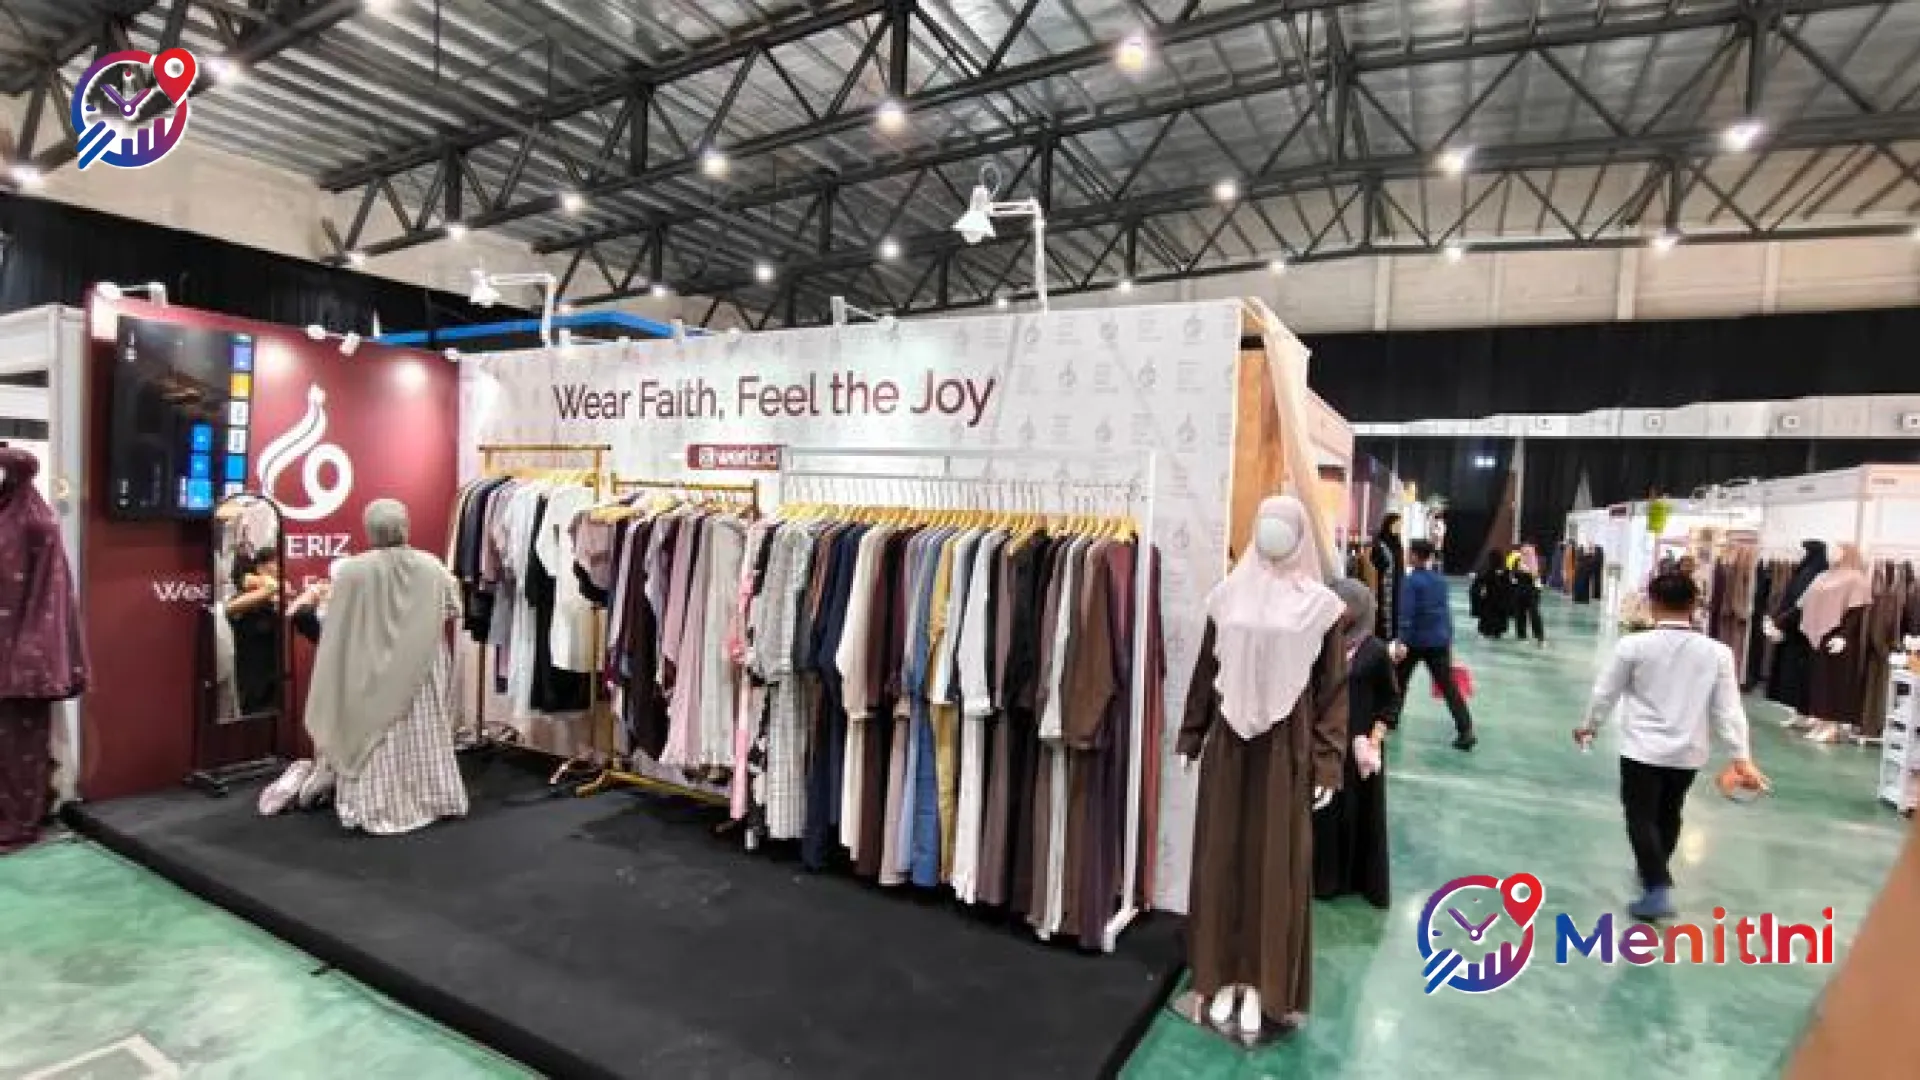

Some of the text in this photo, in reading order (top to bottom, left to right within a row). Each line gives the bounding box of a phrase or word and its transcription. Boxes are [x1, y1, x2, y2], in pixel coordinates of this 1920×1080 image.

[551, 368, 997, 428] Wear Faith, Feel the Joy
[284, 533, 351, 558] ERIZ
